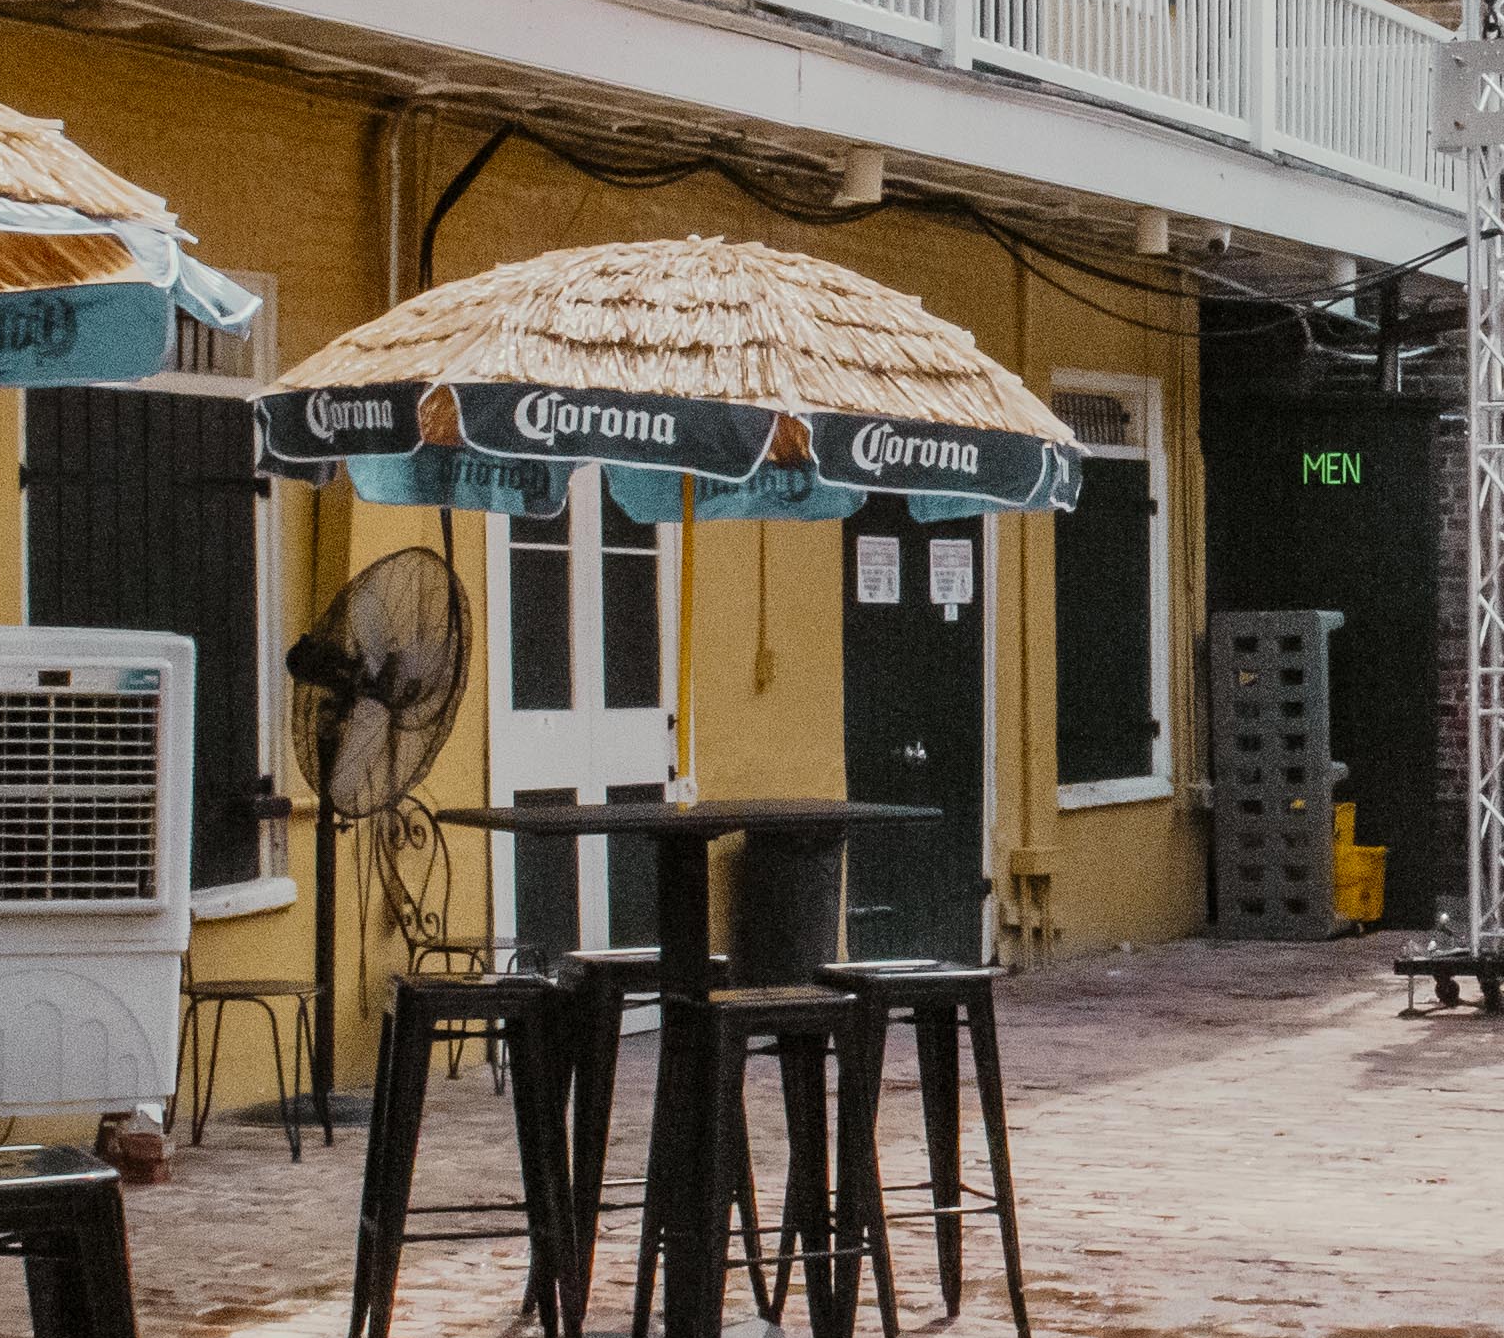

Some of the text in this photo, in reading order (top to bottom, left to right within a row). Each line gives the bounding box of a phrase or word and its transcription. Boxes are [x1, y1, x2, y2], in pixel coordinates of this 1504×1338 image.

[303, 390, 395, 440] Corona
[513, 390, 678, 447] Corona
[851, 422, 980, 477] Corona
[1302, 452, 1362, 486] MEN
